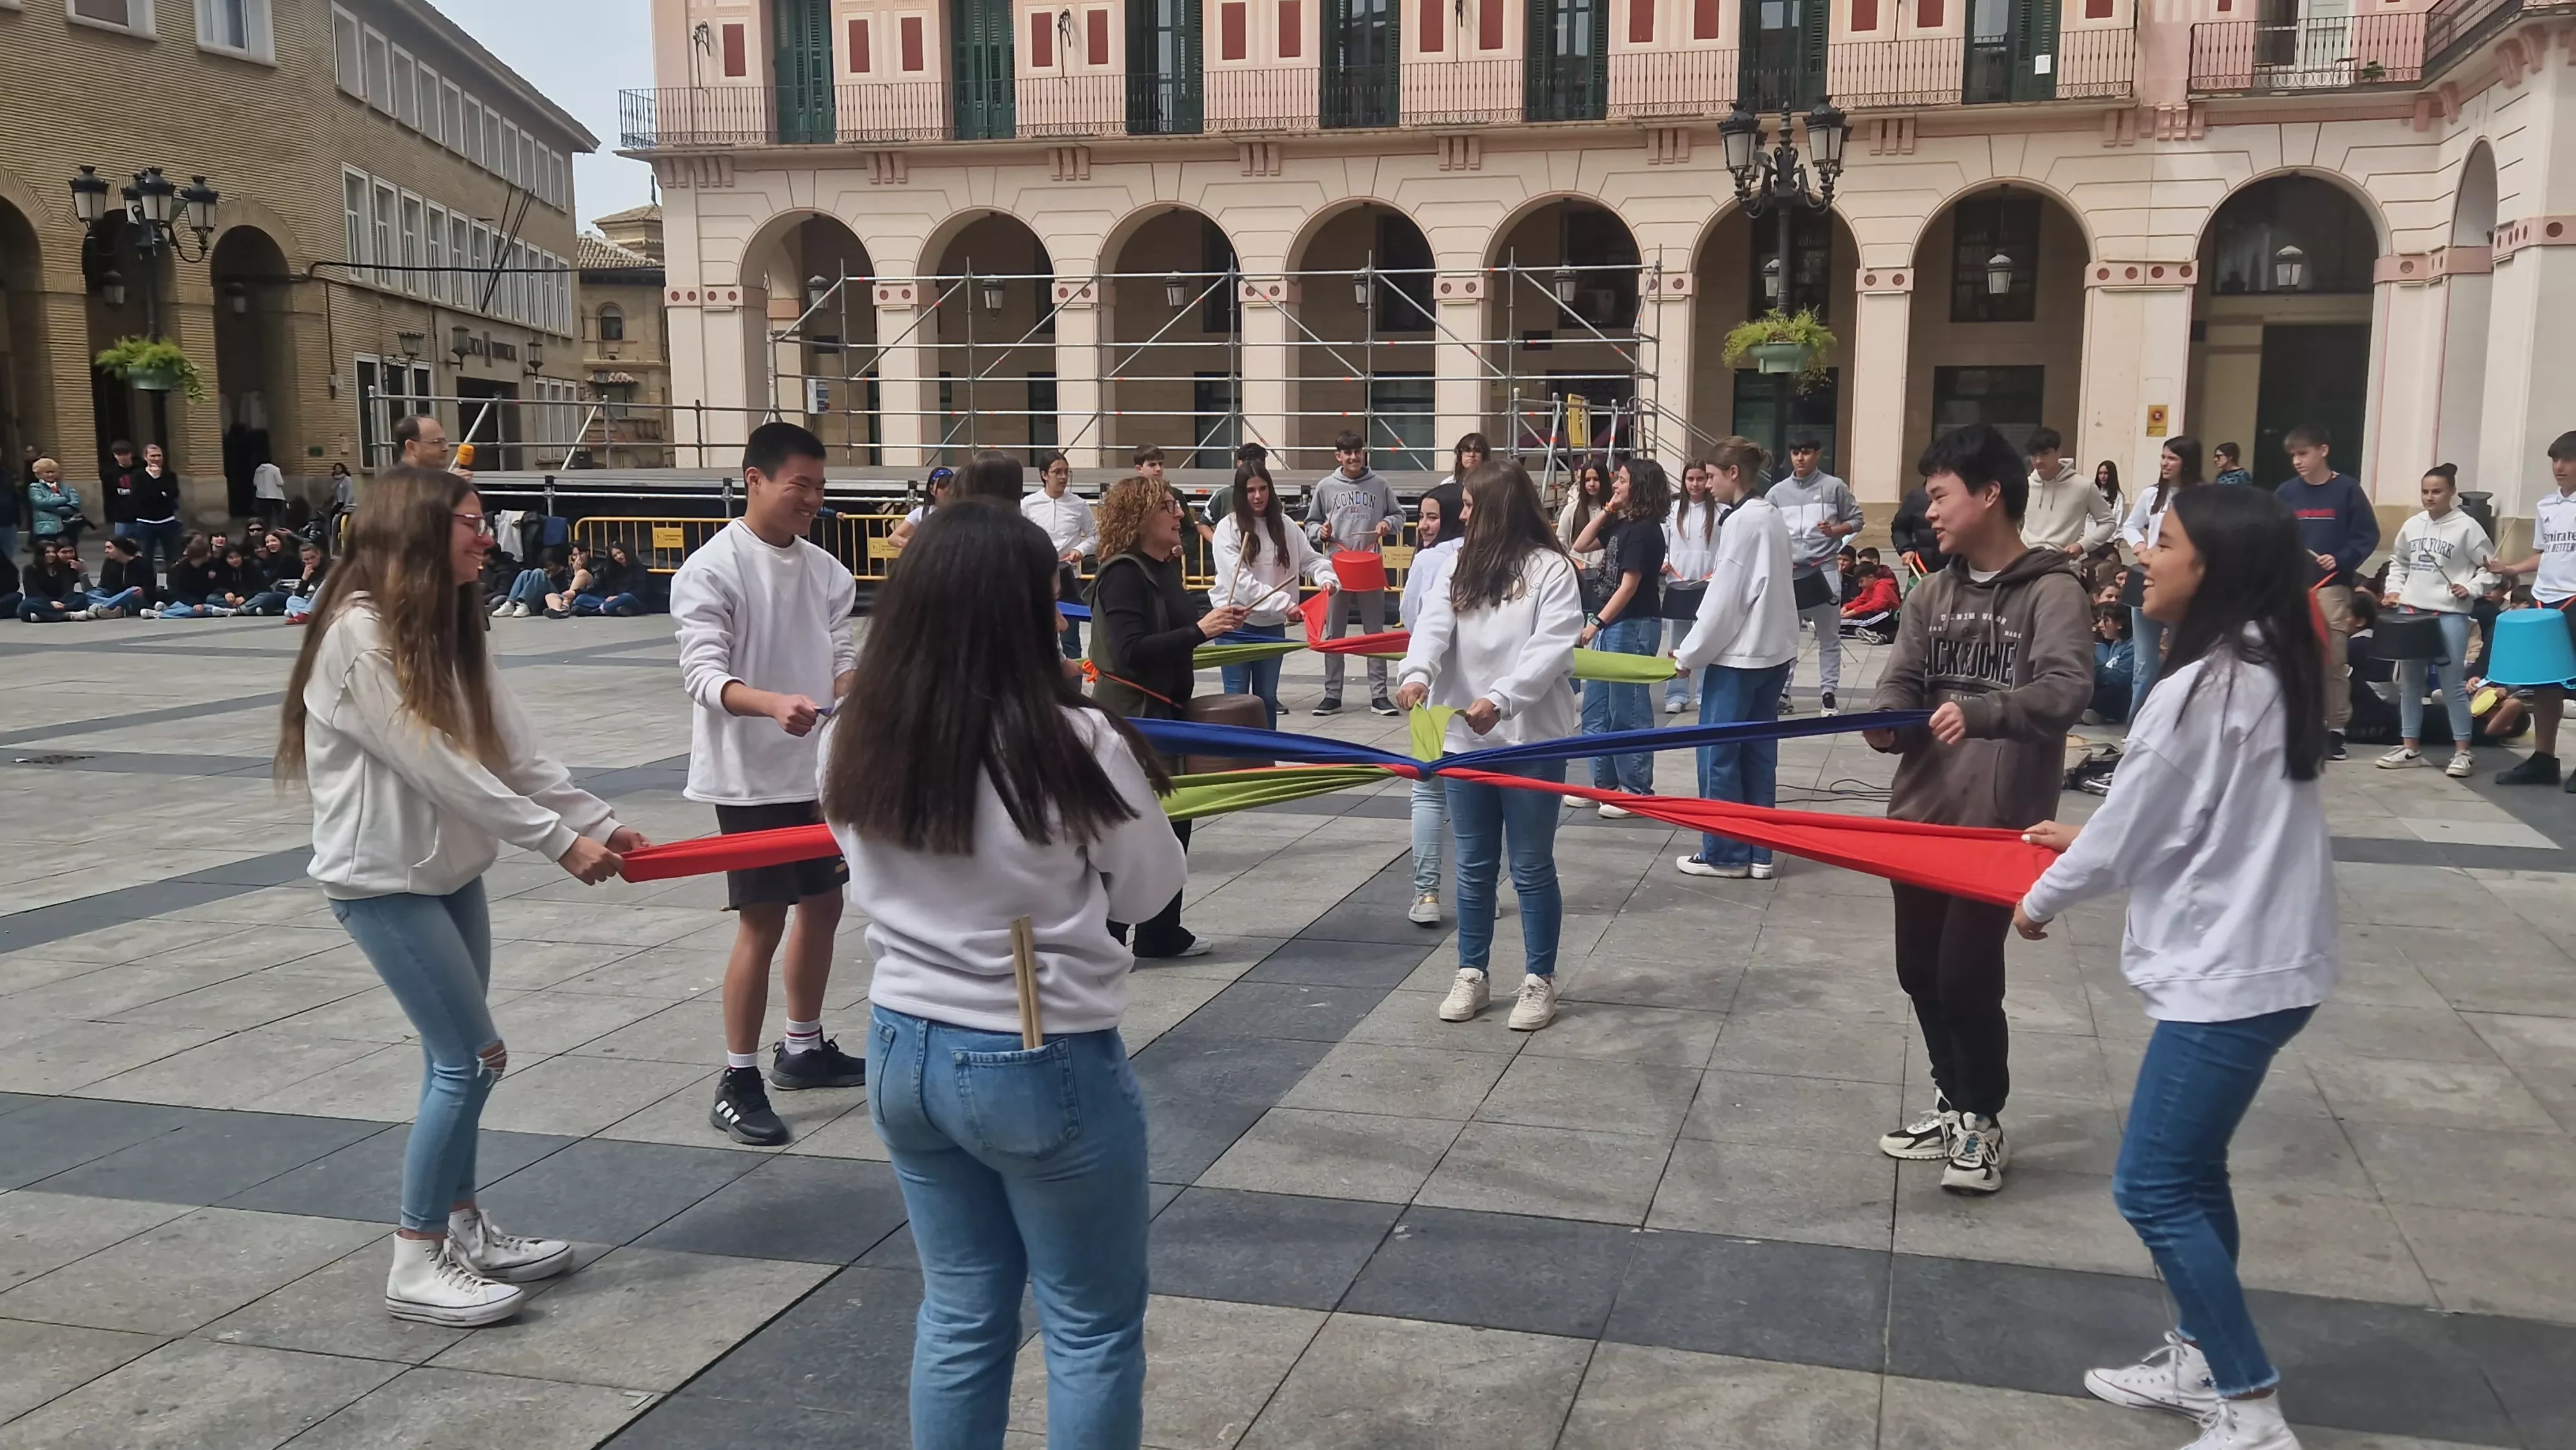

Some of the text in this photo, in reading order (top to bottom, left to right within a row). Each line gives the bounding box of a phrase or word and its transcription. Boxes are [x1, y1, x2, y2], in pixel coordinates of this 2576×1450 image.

[1332, 491, 1376, 510] LONDON
[2429, 537, 2455, 560] YORK
[1924, 635, 2018, 692] ACK&JONE
